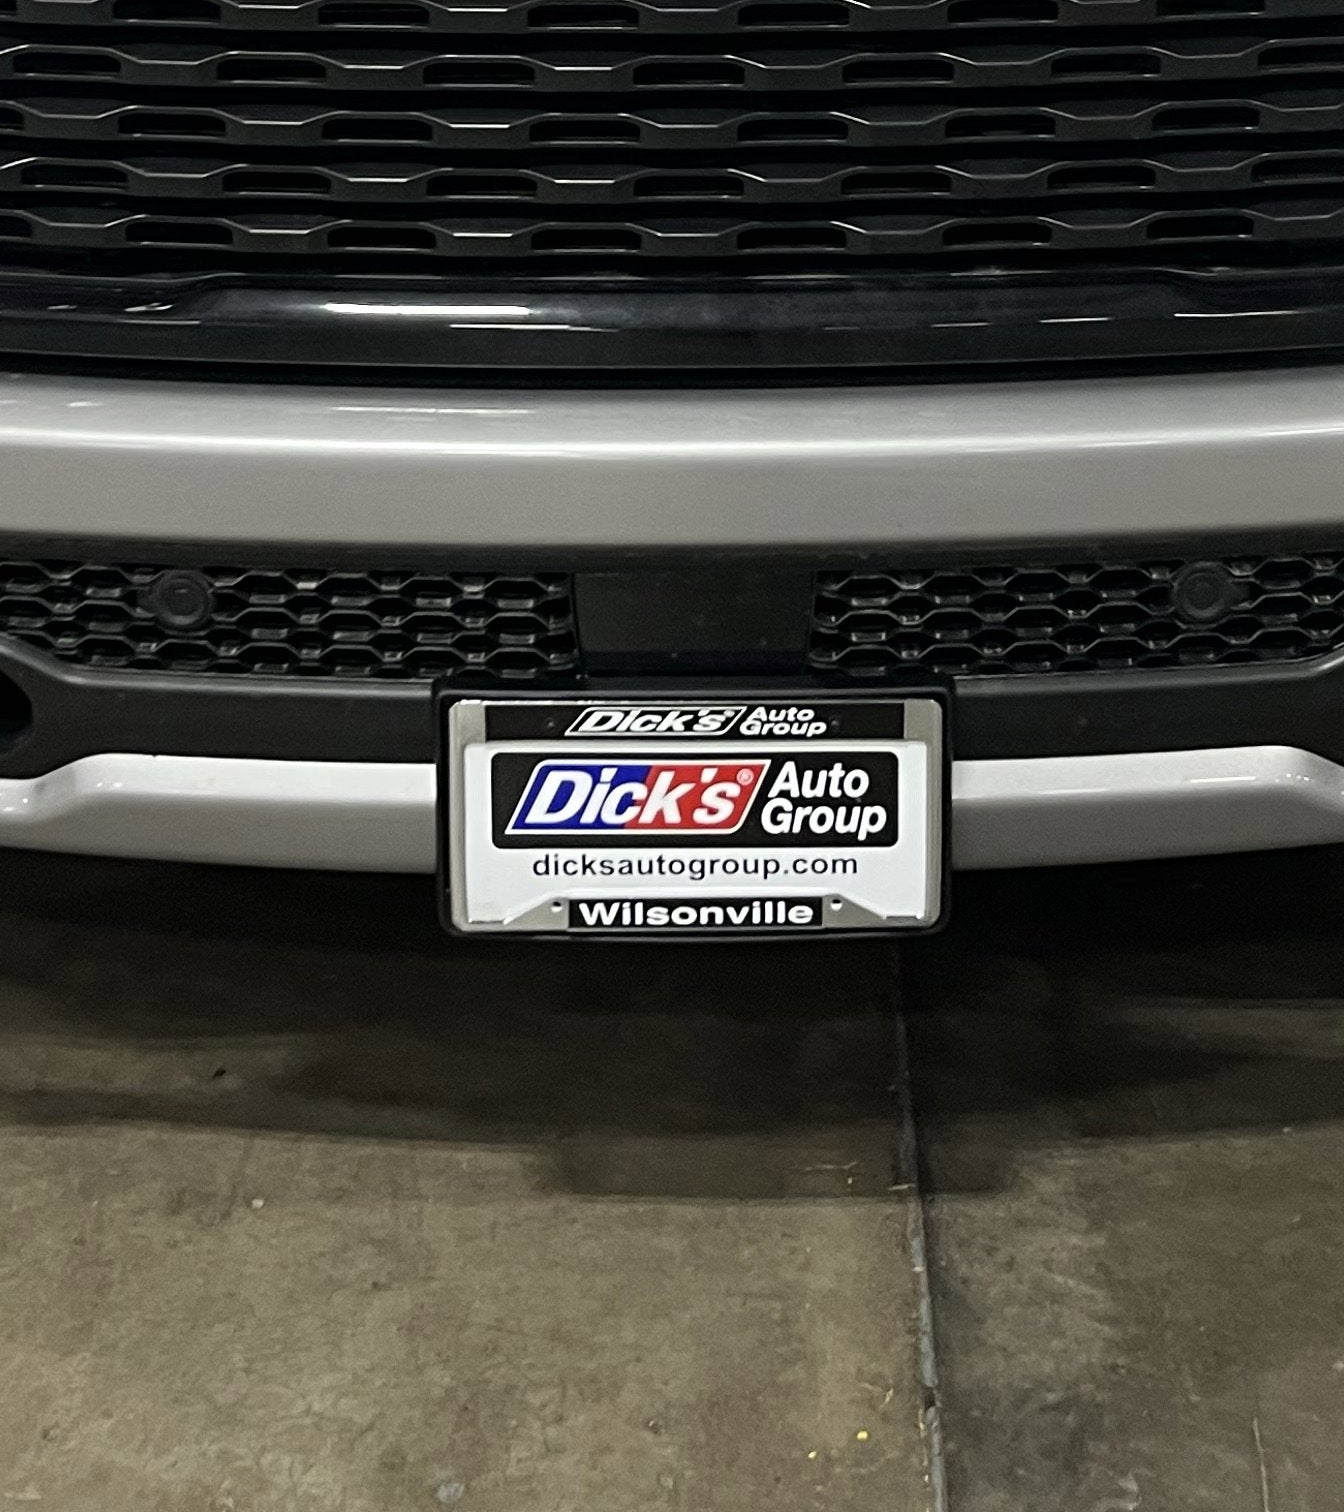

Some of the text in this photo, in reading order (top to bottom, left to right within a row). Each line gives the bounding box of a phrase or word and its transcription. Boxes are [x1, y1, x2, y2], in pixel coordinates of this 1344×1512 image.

[576, 707, 730, 732] Dick's
[745, 706, 815, 722] Auto
[739, 720, 827, 737] Group
[767, 760, 870, 799] Auto
[523, 767, 742, 825] Dick's
[760, 797, 888, 841] Group
[532, 853, 858, 881] dicksautogroup.com
[578, 900, 814, 926] Wilsonville
